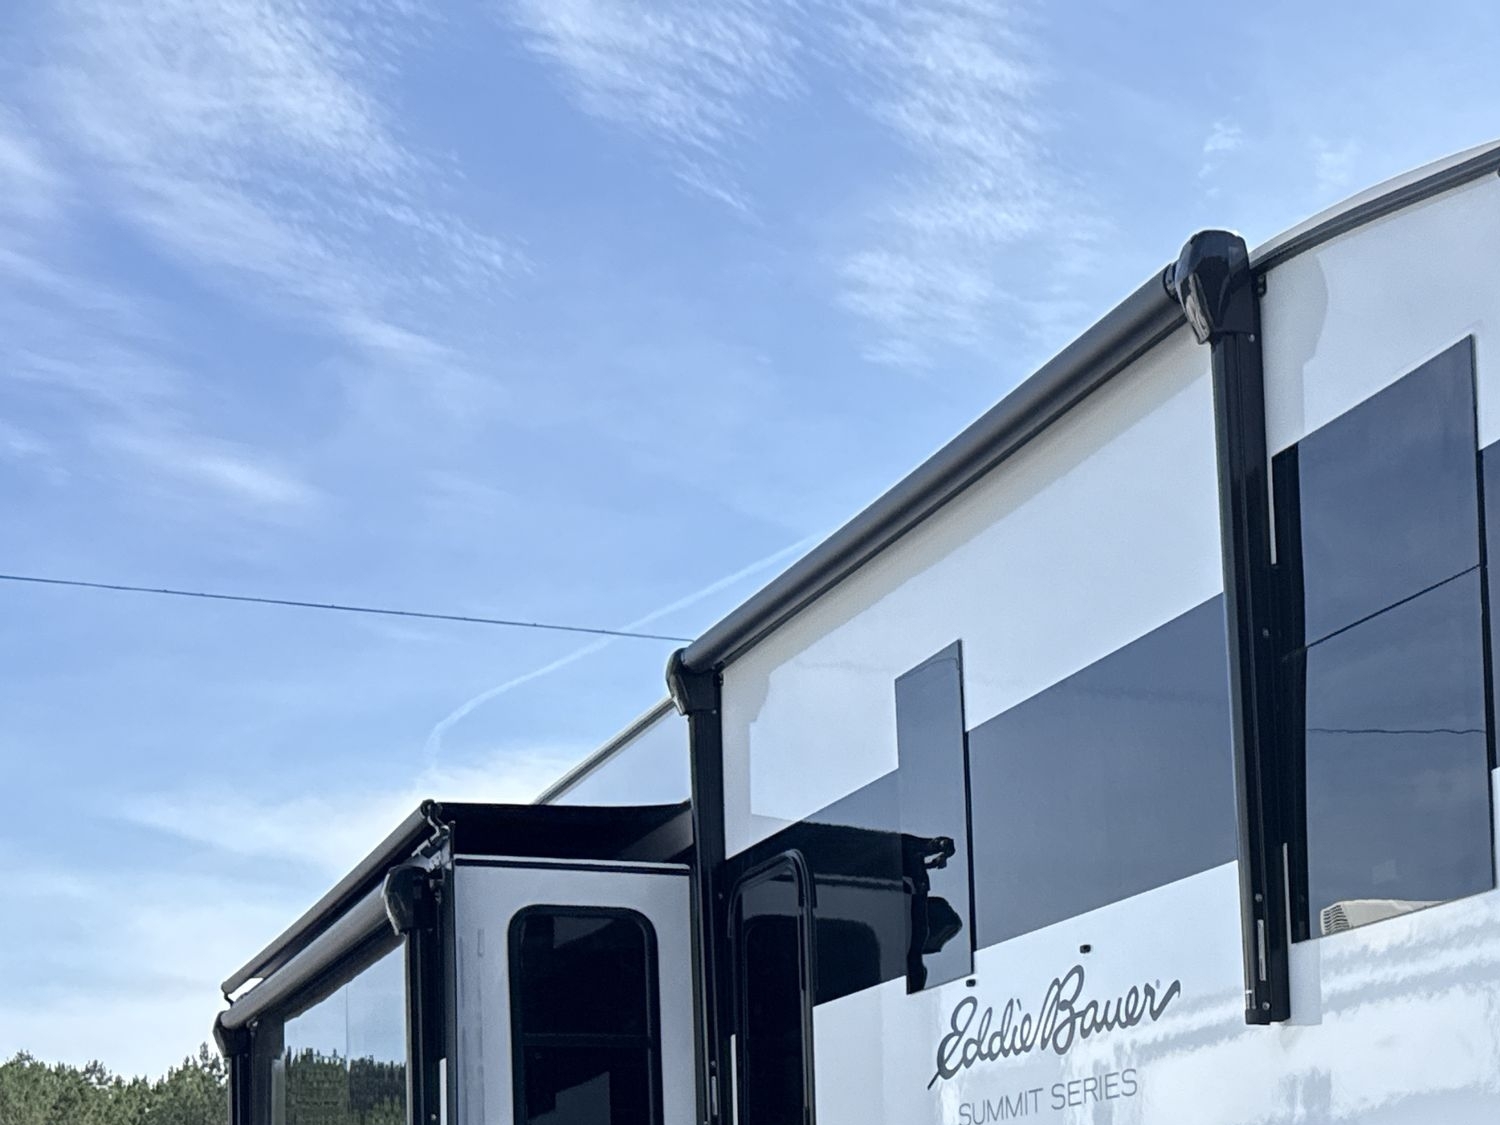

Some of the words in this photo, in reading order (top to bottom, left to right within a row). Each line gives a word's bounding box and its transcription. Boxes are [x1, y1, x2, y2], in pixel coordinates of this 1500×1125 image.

[927, 996, 1036, 1090] Eddie
[1038, 964, 1182, 1055] Bauer
[1050, 1068, 1138, 1111] SERIES
